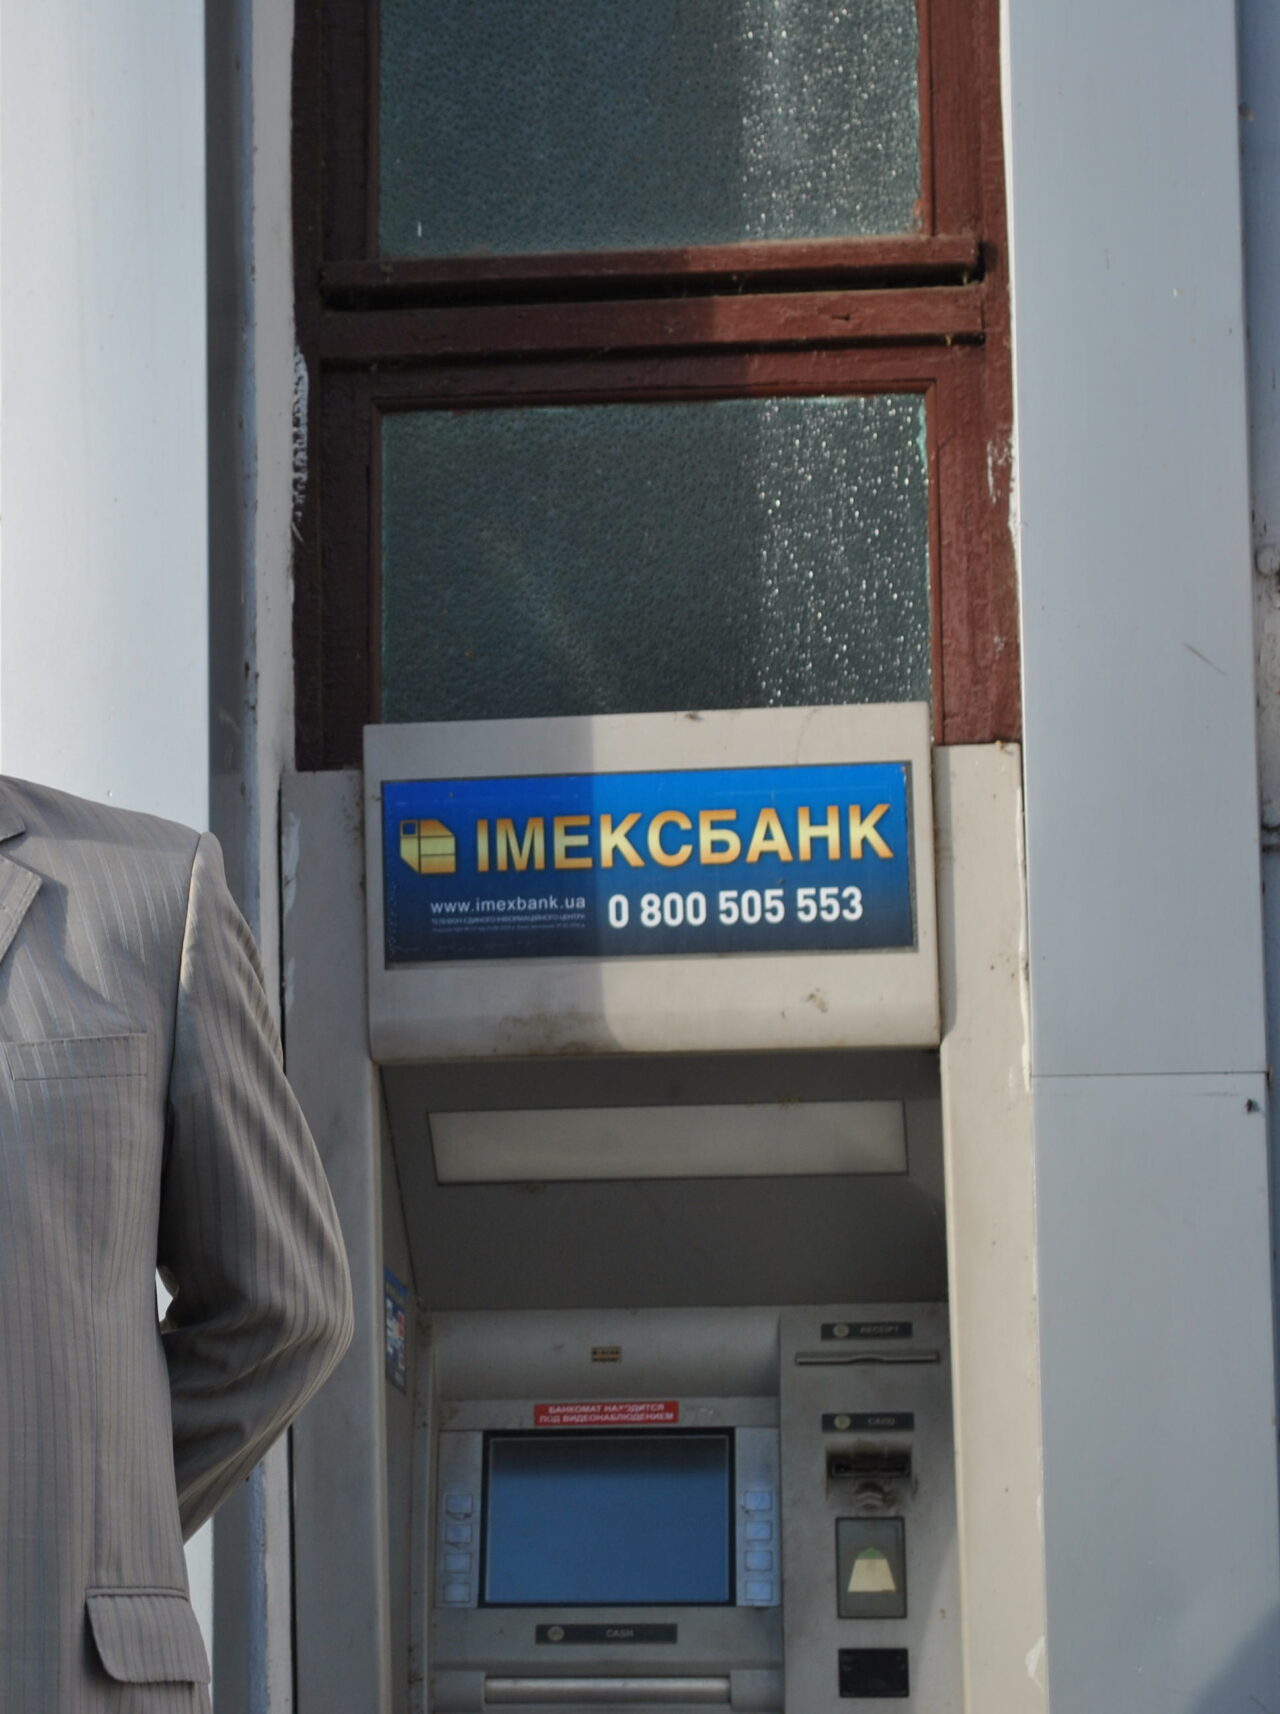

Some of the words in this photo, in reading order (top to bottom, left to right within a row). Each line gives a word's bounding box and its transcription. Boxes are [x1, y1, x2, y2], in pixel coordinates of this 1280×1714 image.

[476, 803, 894, 873] ІМЕКСБАНК
[430, 894, 586, 914] www.imexbank.ua
[608, 894, 629, 928] 0
[640, 891, 707, 926] 800
[718, 889, 786, 925] 505
[796, 886, 864, 922] 553
[548, 1404, 601, 1414] БАНКОМАТ
